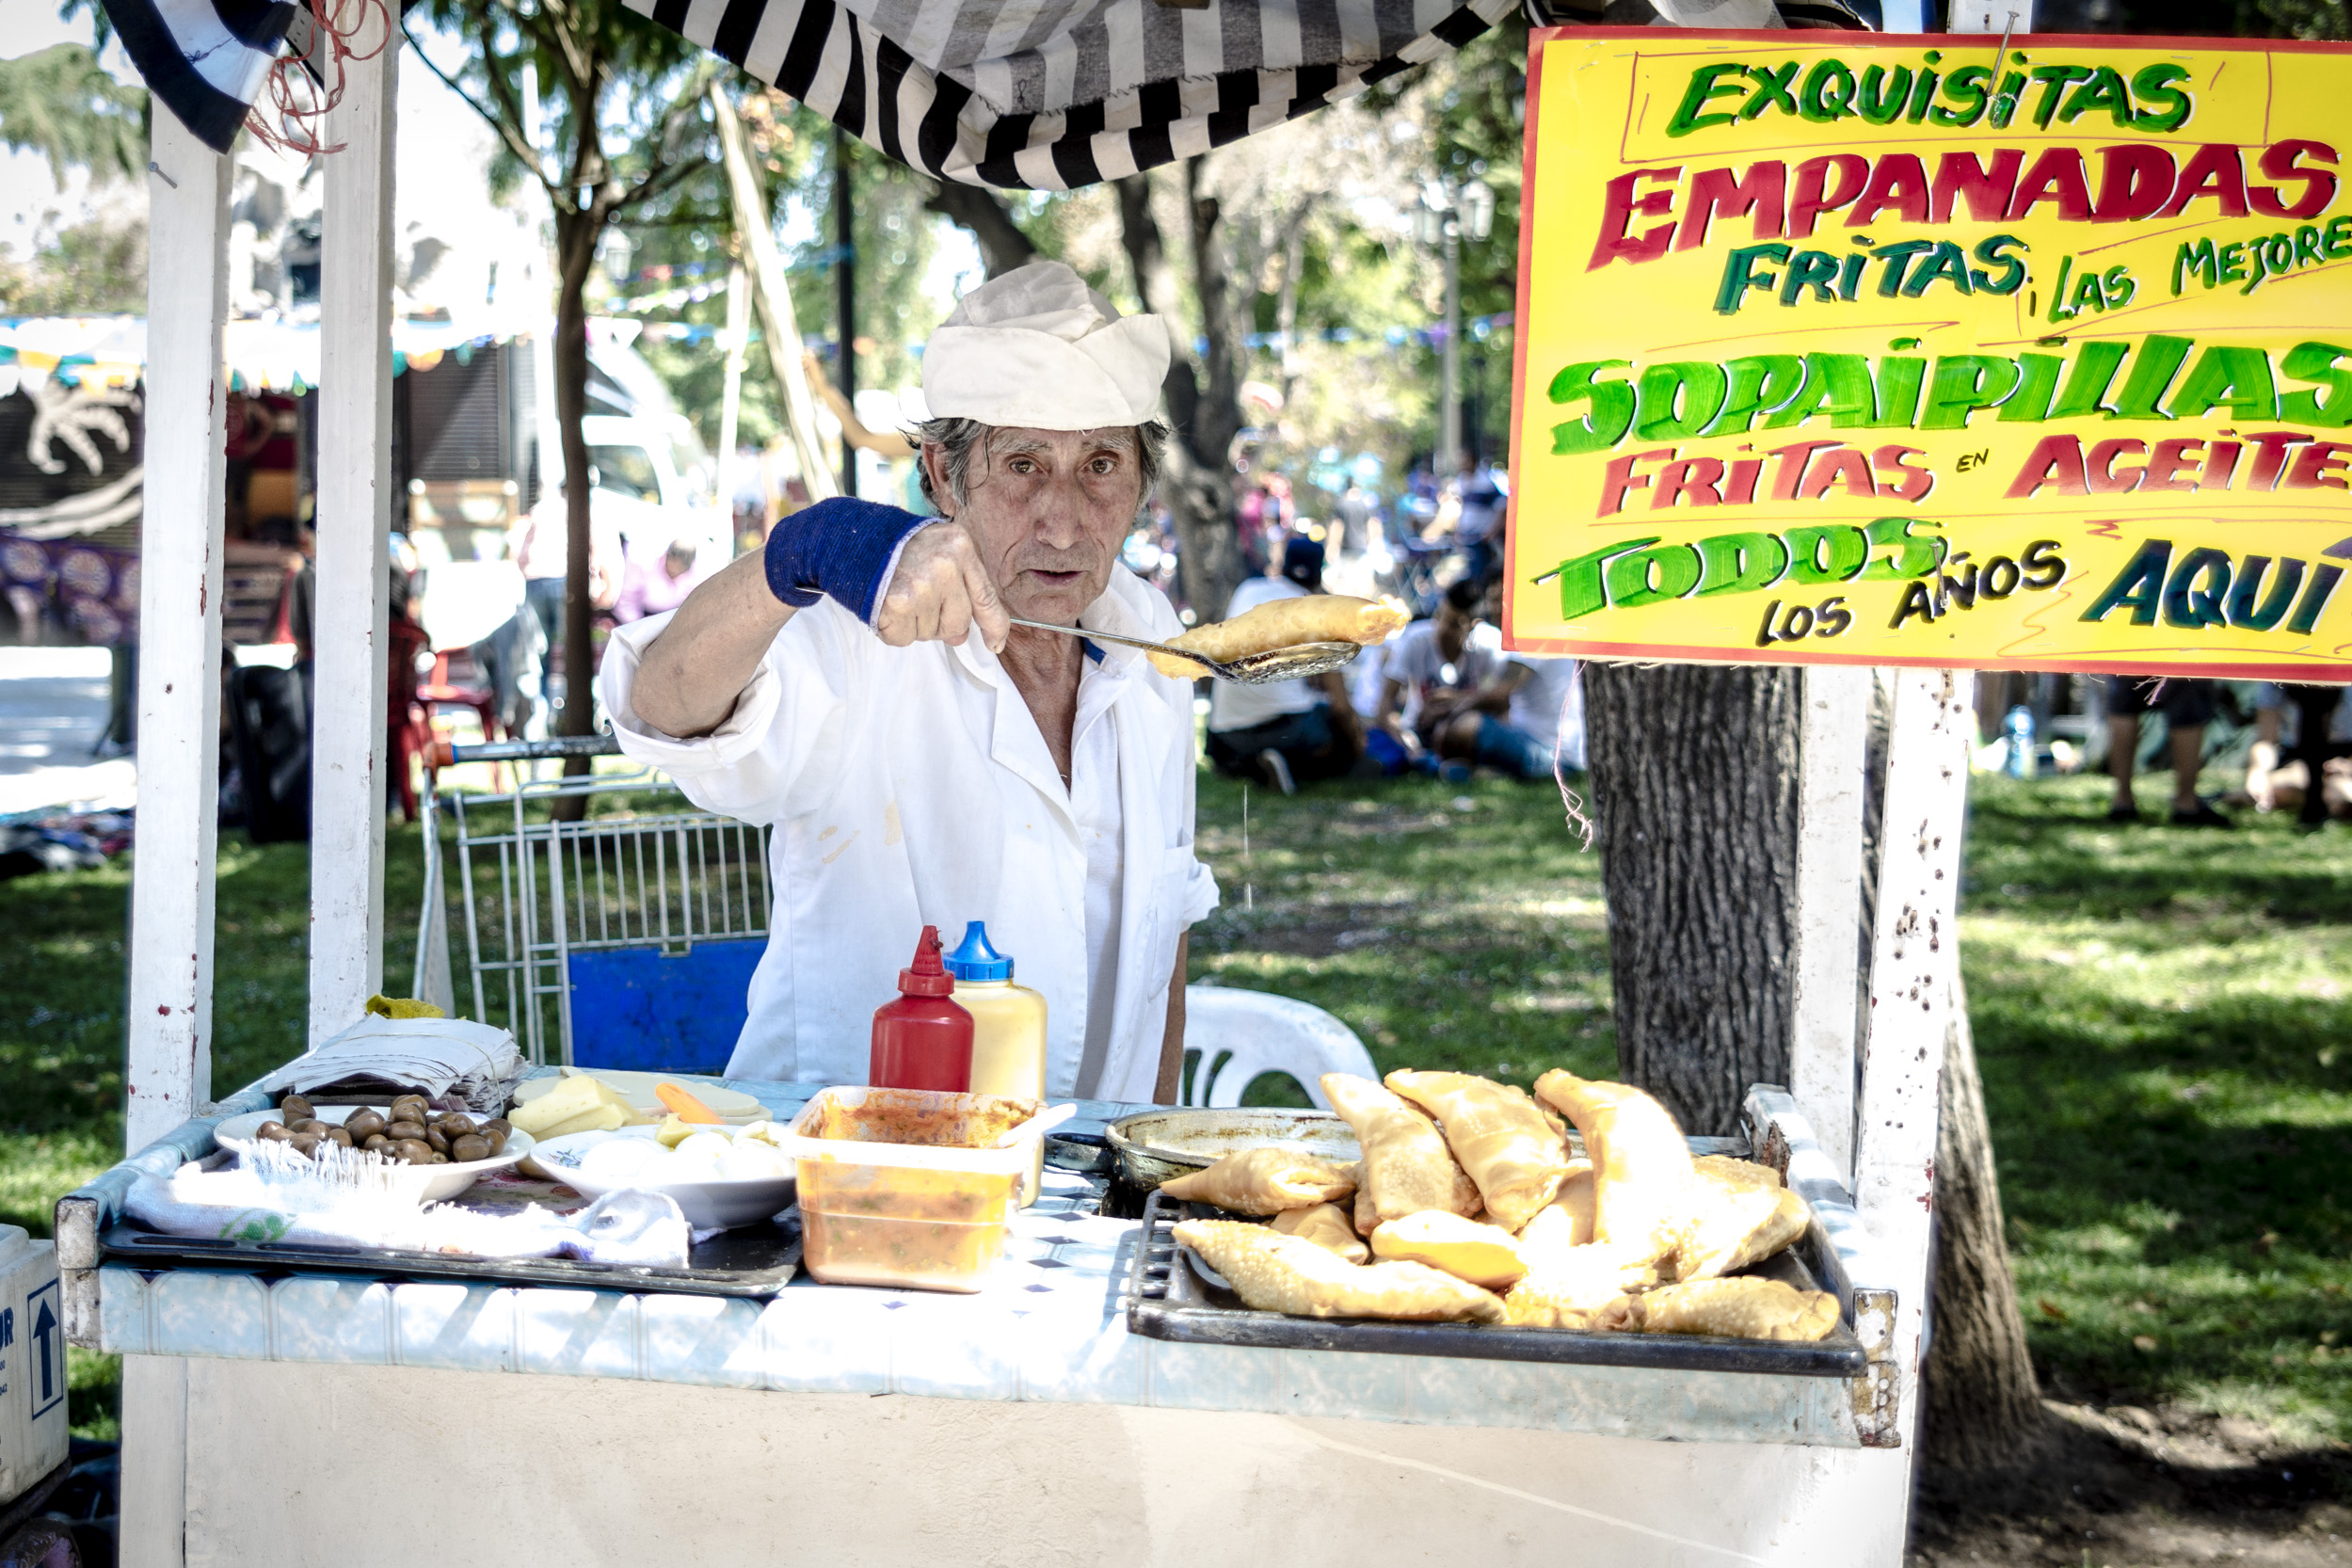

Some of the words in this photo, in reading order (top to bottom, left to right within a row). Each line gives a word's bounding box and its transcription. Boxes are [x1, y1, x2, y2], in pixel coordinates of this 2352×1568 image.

[1665, 50, 2192, 137] EXQUISITAS
[1585, 139, 2341, 273] EMPANADAS
[1712, 233, 2031, 316] FRITAS
[1548, 334, 2352, 456] SOPAIPILLAS
[1596, 441, 1936, 518] FRITAS
[1956, 447, 1989, 474] EN
[1530, 518, 1953, 620] TODOS
[1754, 596, 1855, 648] LOS
[1887, 539, 2070, 630] AÑOS
